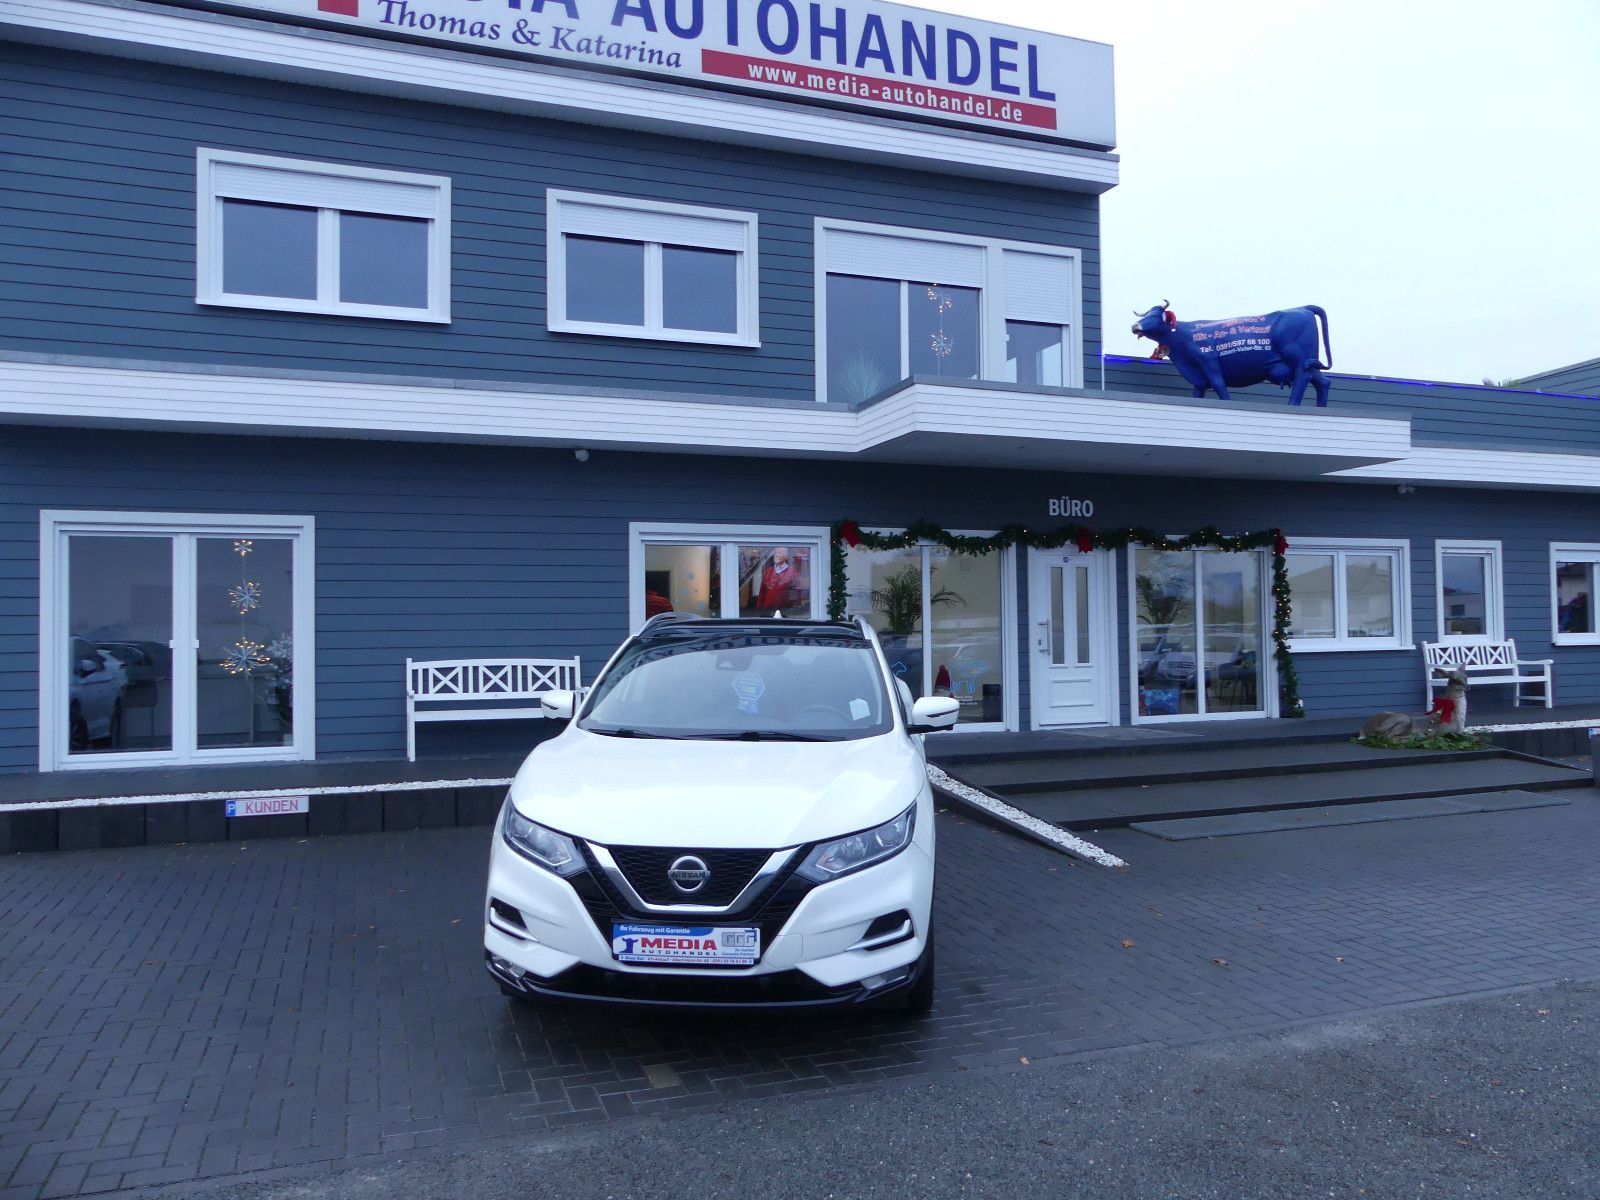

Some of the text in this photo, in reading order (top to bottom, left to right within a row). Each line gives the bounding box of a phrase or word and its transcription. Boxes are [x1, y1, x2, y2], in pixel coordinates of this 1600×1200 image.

[377, 0, 501, 40] Thomas
[511, 18, 541, 46] &
[549, 25, 682, 69] Katarina
[748, 60, 1023, 122] www.media-autohandel.de
[1049, 496, 1094, 517] BÜRO
[245, 800, 299, 814] KUNDEN
[629, 926, 654, 934] Fahrzeug
[641, 937, 717, 950] MEDIA
